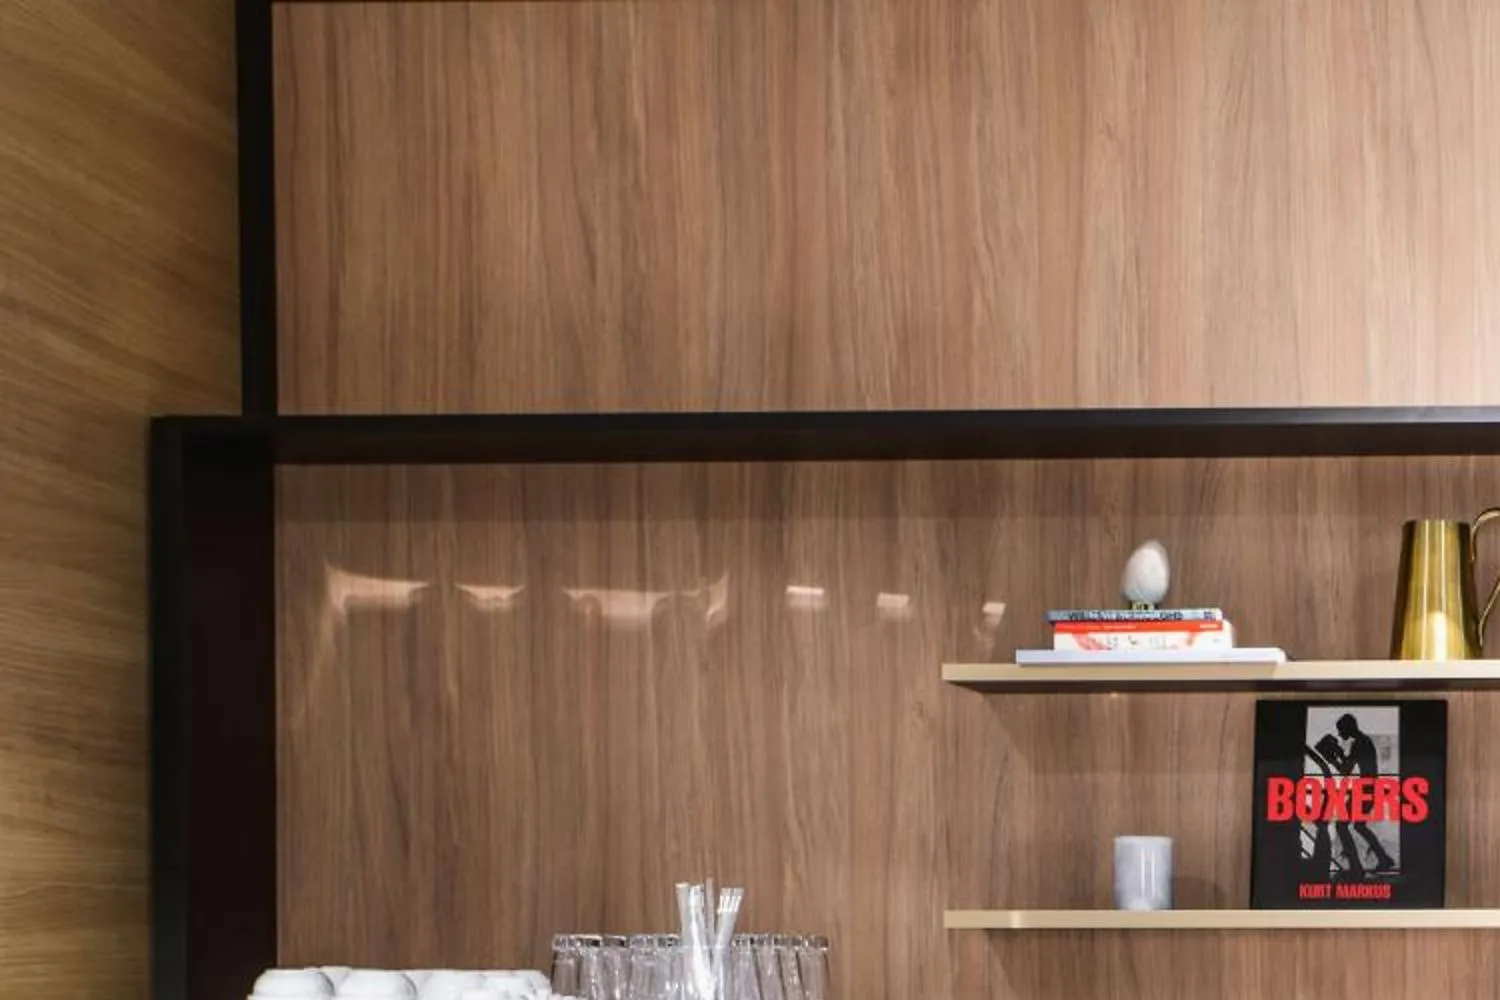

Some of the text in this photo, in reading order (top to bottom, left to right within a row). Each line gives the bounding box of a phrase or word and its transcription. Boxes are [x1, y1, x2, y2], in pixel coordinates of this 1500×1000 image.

[1266, 777, 1430, 823] BOXERS
[1299, 883, 1392, 898] KURT MARKUS
